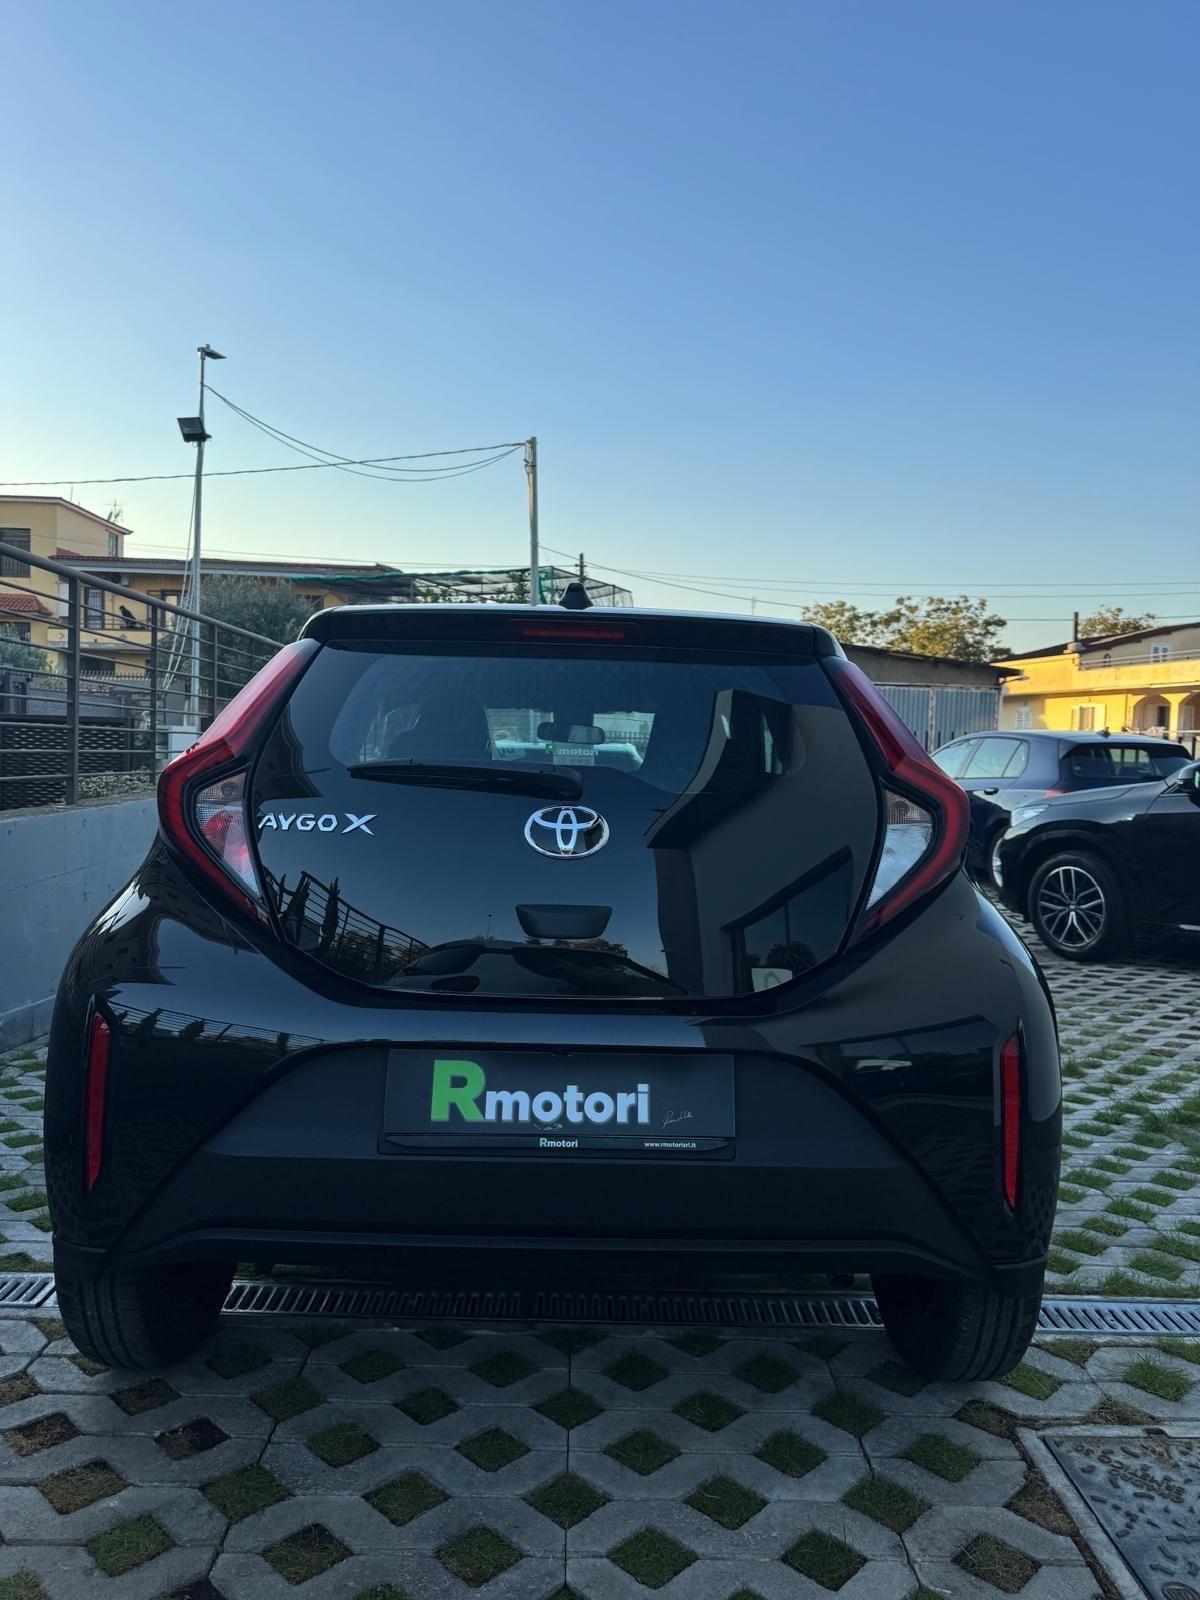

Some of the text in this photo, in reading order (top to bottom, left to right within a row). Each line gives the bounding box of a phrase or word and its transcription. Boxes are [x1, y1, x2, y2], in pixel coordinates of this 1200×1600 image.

[258, 813, 378, 836] AYGO X
[431, 1060, 649, 1123] Rmotori
[539, 1138, 578, 1148] Rmotori
[644, 1141, 697, 1149] www.rmotorisrl.it
